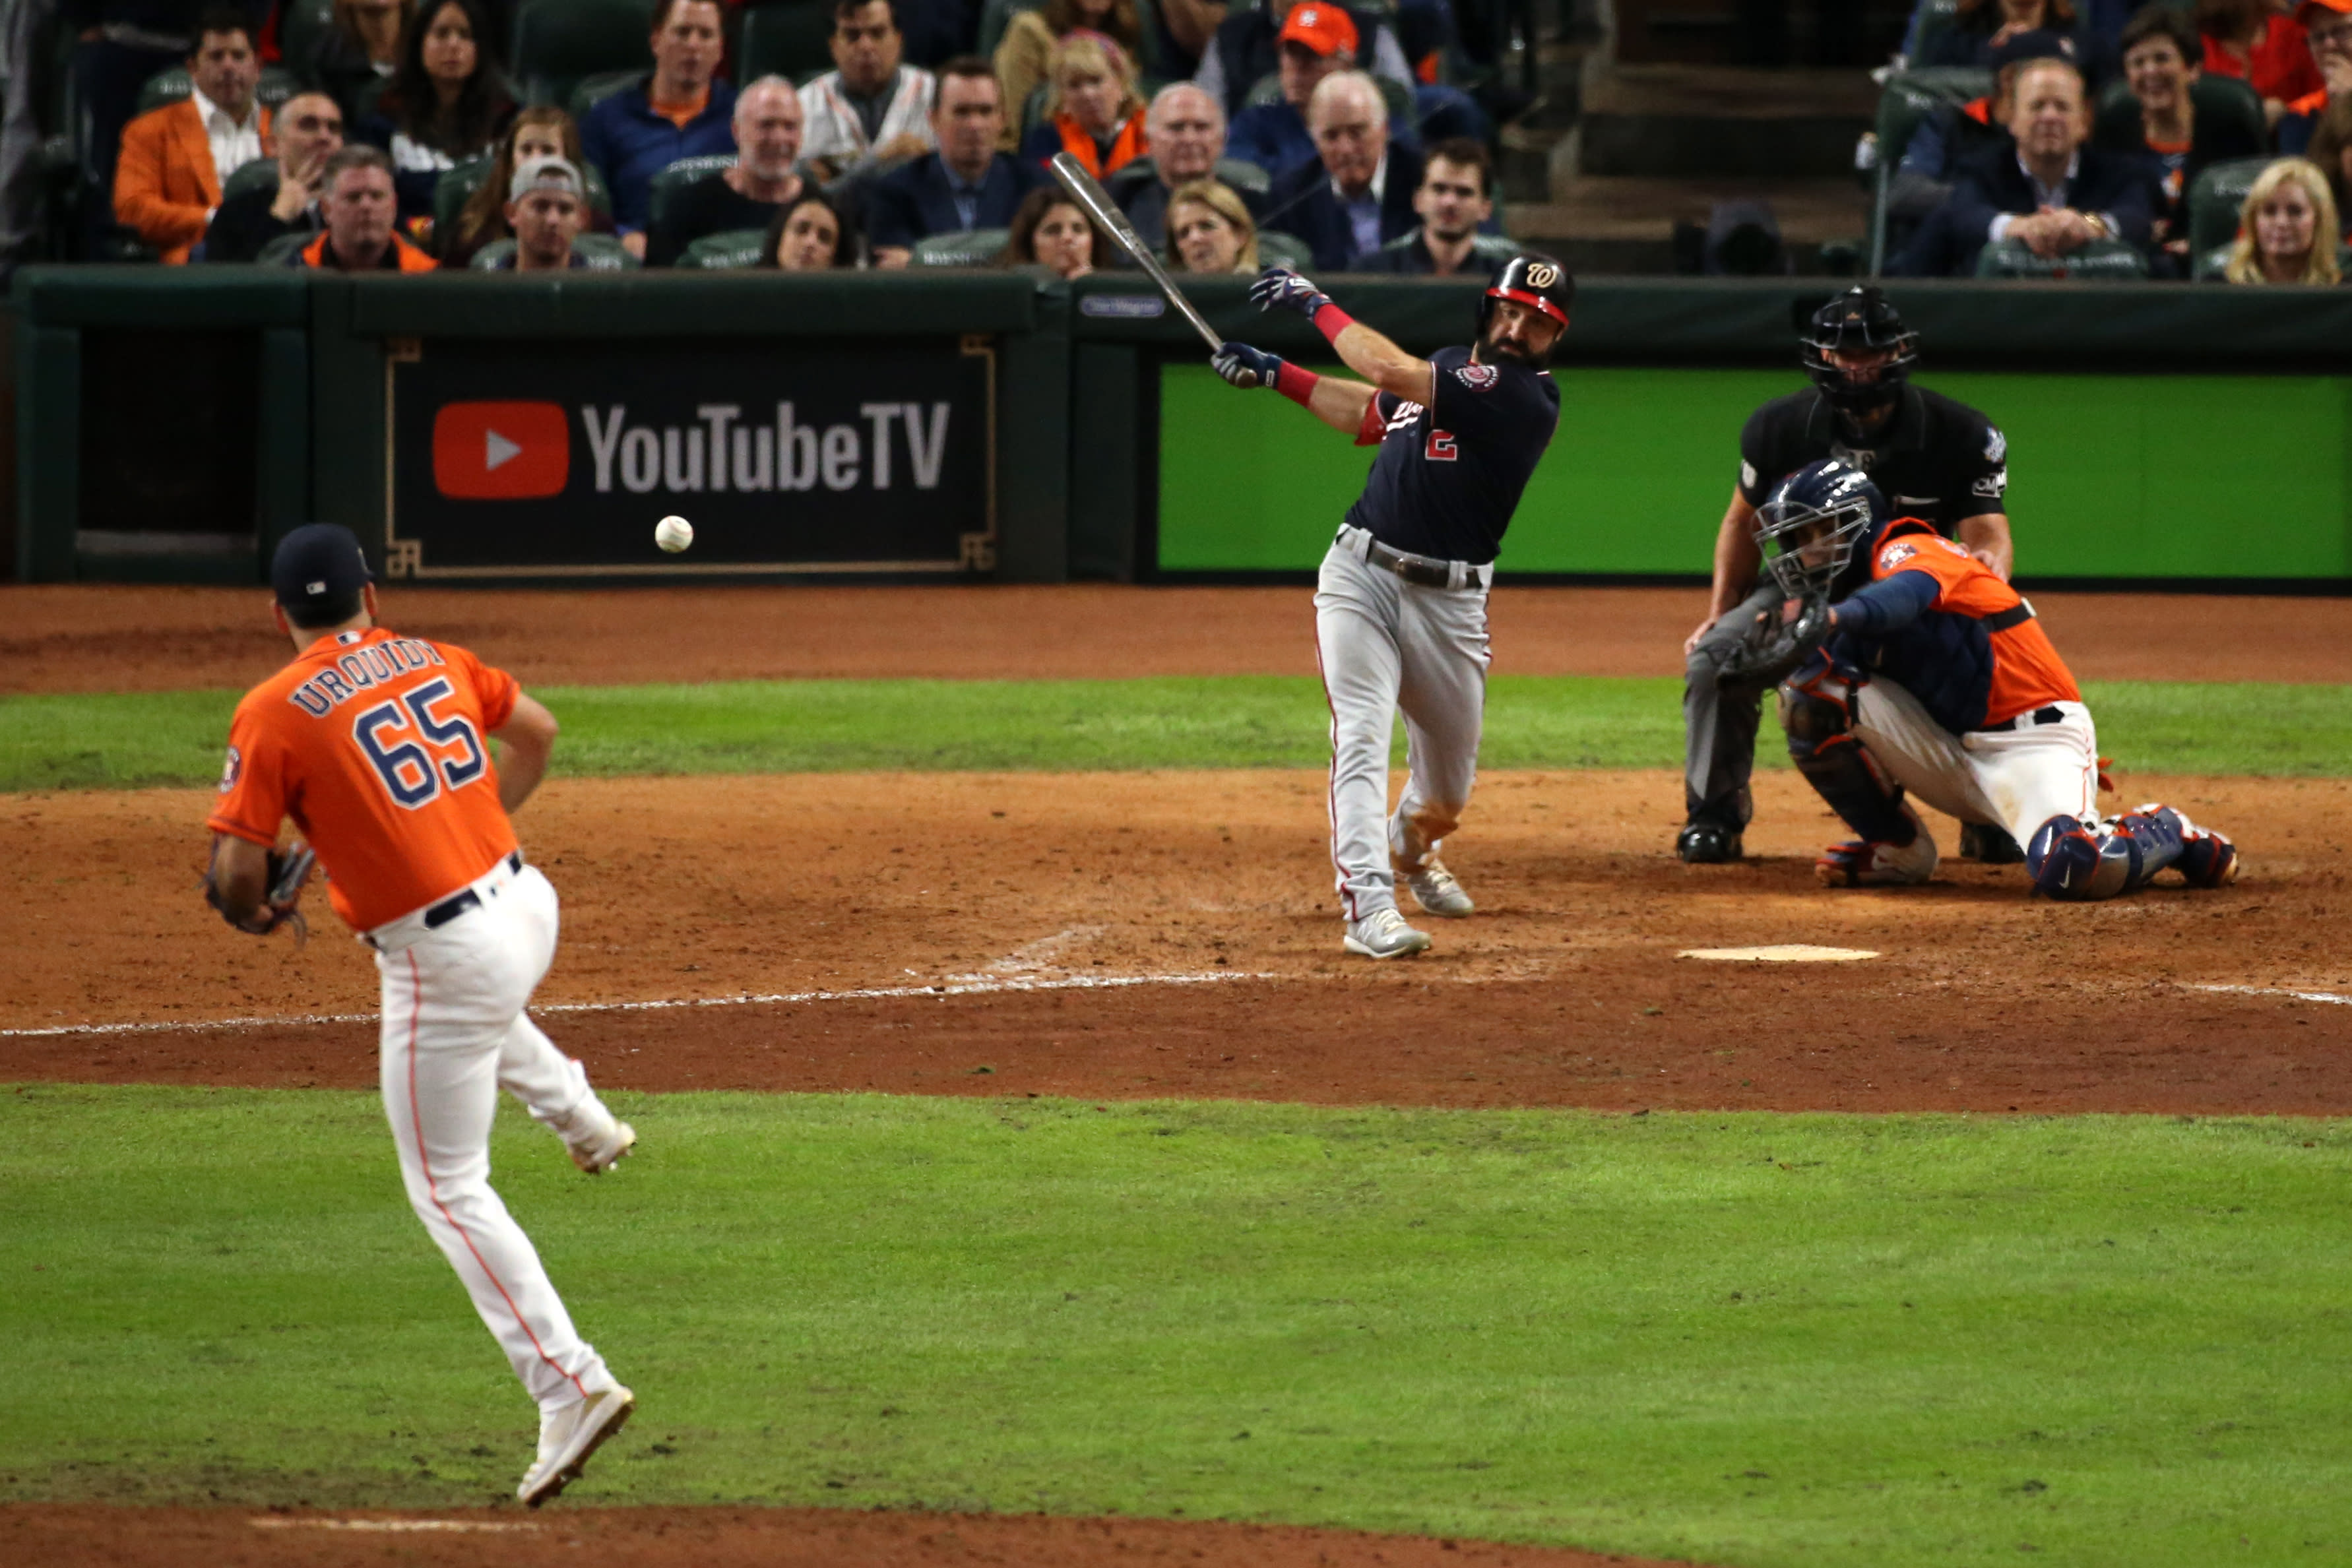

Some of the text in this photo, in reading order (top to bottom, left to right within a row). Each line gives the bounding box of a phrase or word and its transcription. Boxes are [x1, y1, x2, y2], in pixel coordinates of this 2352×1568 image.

[1425, 429, 1457, 460] 2
[288, 638, 445, 719] URQUIDY
[352, 675, 487, 811] 65
